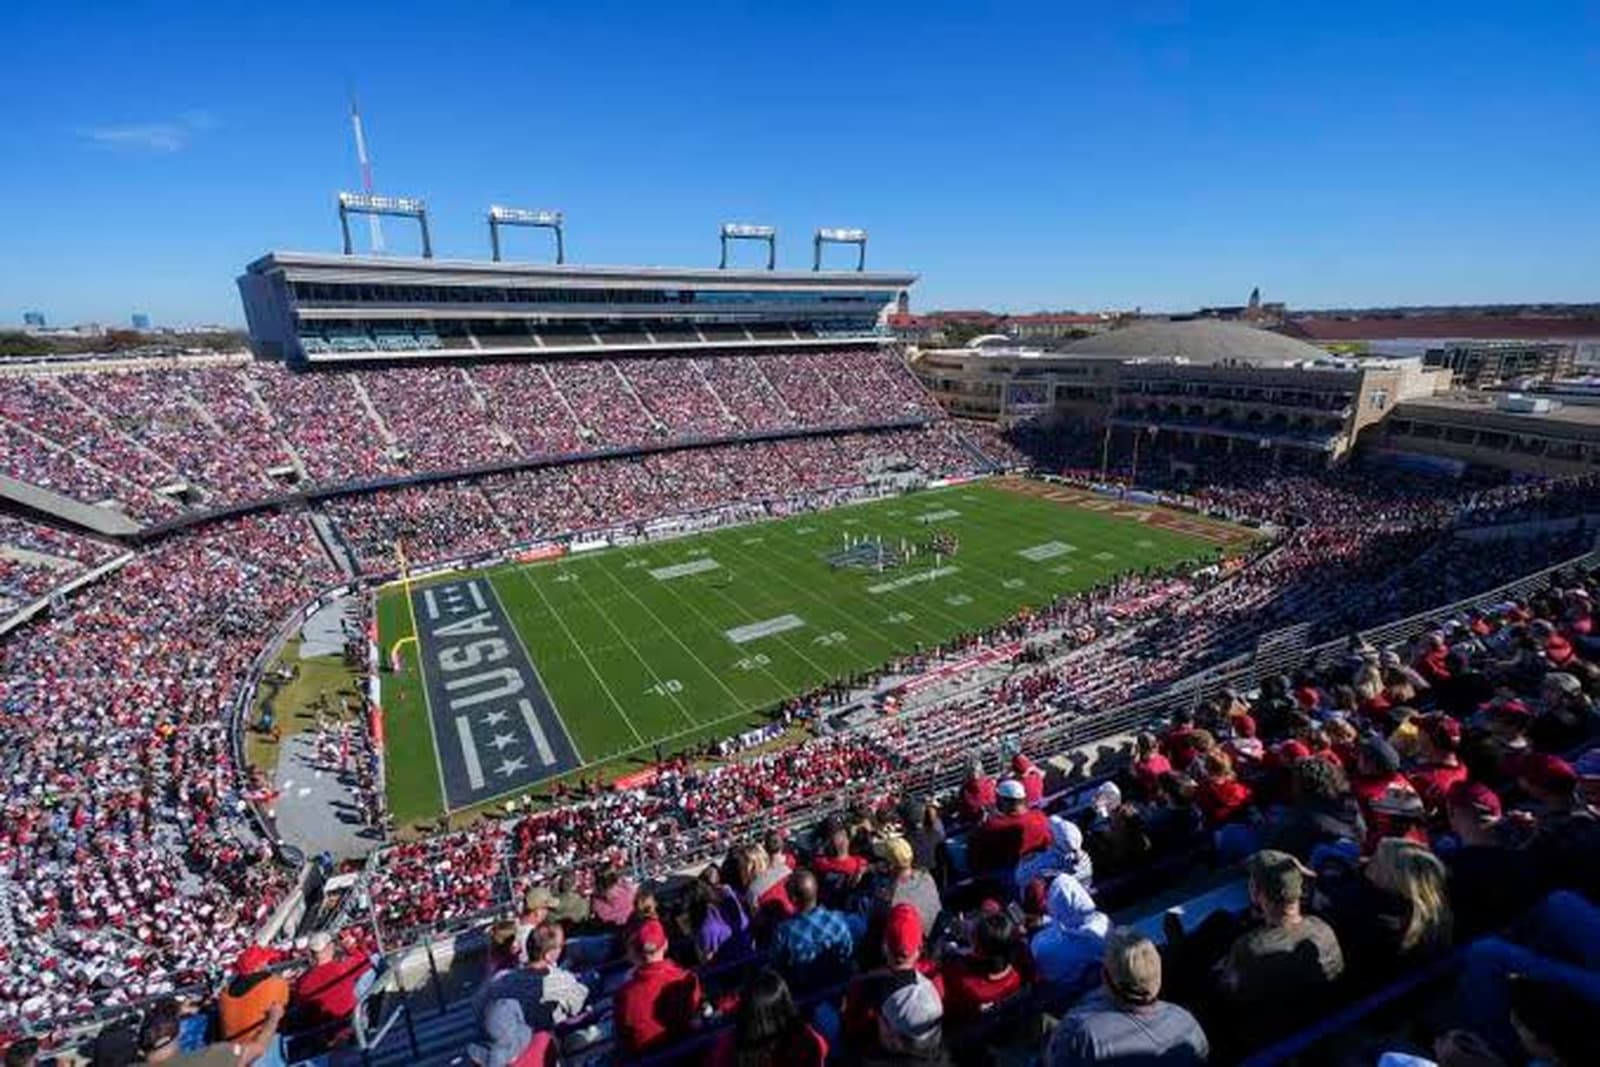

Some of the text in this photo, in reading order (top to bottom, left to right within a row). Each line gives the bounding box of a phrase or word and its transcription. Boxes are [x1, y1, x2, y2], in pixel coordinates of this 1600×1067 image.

[433, 611, 525, 709] USA
[738, 653, 771, 670] 20
[654, 679, 682, 696] 10
